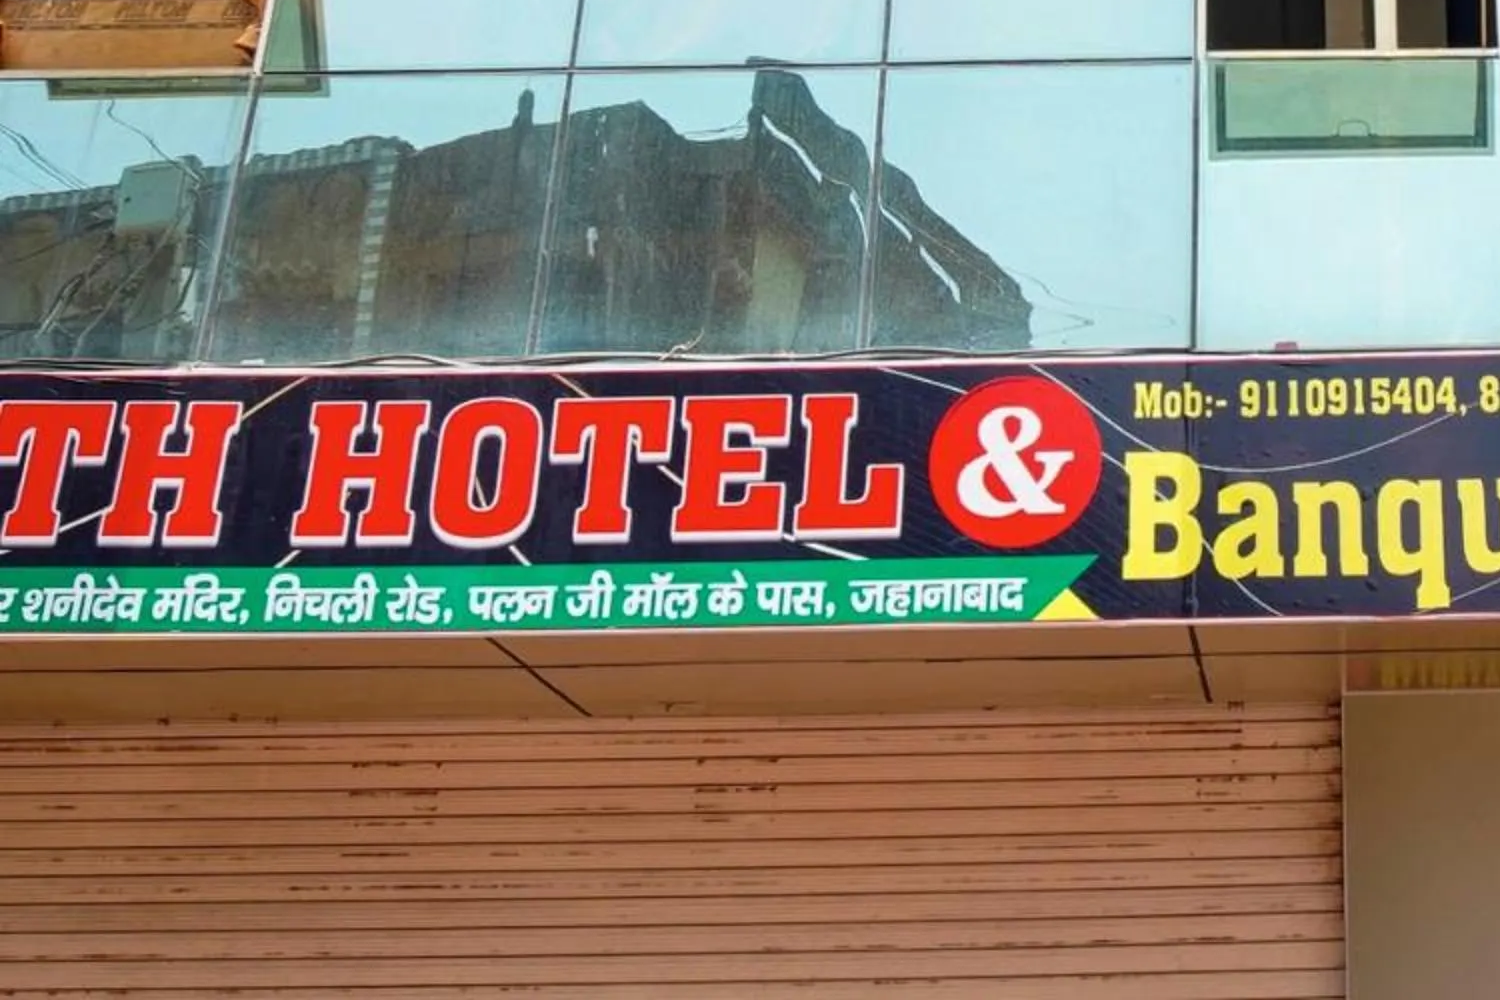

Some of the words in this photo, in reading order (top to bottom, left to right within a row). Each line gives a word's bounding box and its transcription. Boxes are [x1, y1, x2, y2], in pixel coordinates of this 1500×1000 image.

[1134, 380, 1228, 420] Mob:-
[1239, 376, 1468, 418] 9110915404,
[289, 393, 905, 546] HOTEL
[957, 405, 1074, 518] &
[21, 573, 147, 623] शनीदेव
[264, 572, 381, 624] निचली
[386, 573, 452, 625] रोड,
[565, 569, 616, 619] जी
[622, 571, 702, 620] मॉल
[708, 569, 748, 616] के
[756, 580, 836, 618] पास,
[848, 577, 1028, 617] जहानाबाद
